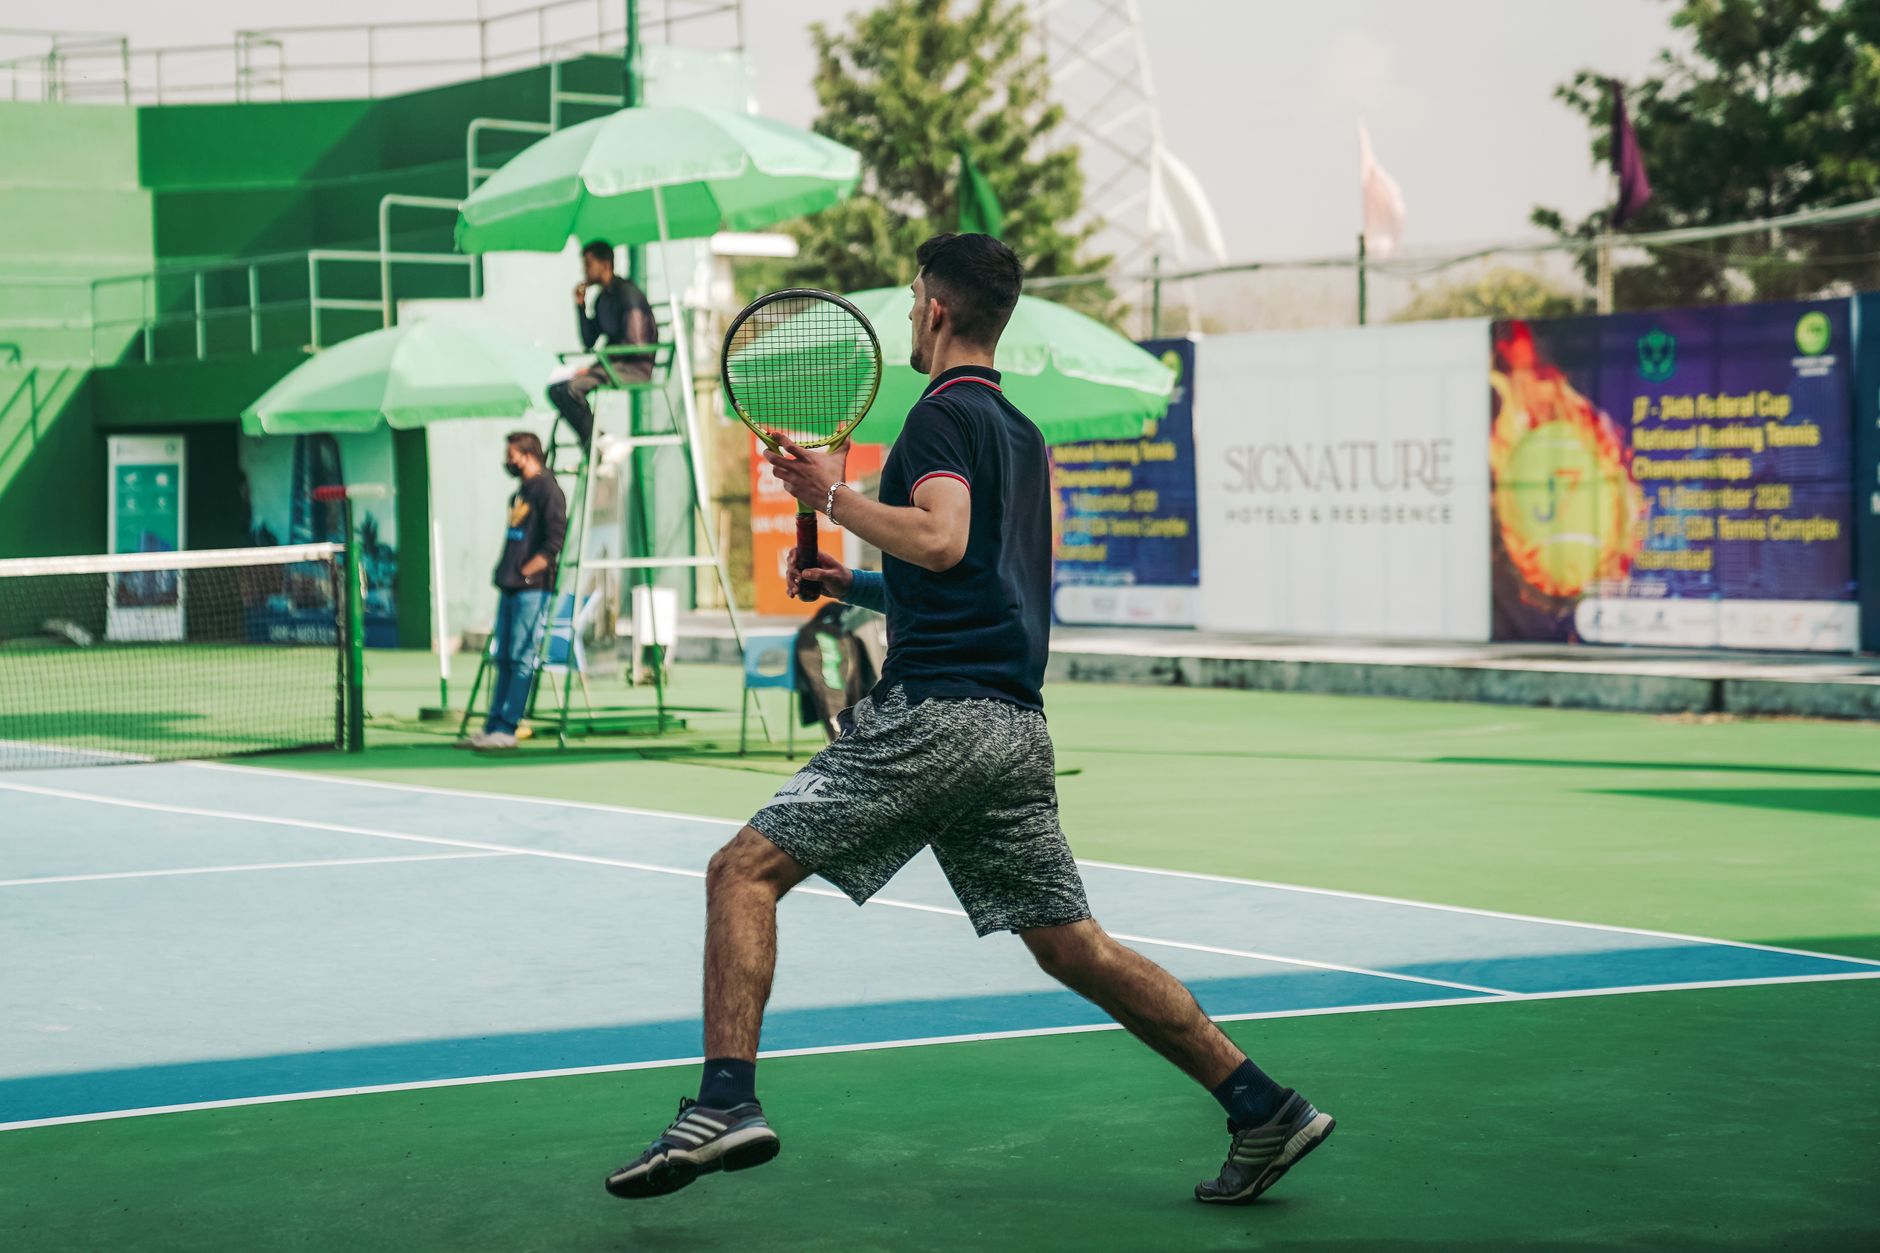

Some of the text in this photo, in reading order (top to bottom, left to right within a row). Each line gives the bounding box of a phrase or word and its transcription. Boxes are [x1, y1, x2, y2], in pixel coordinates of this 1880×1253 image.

[1222, 438, 1455, 497] SIGNATURE
[1225, 504, 1300, 524] HOTELS
[1330, 503, 1452, 524] RESIDENCE
